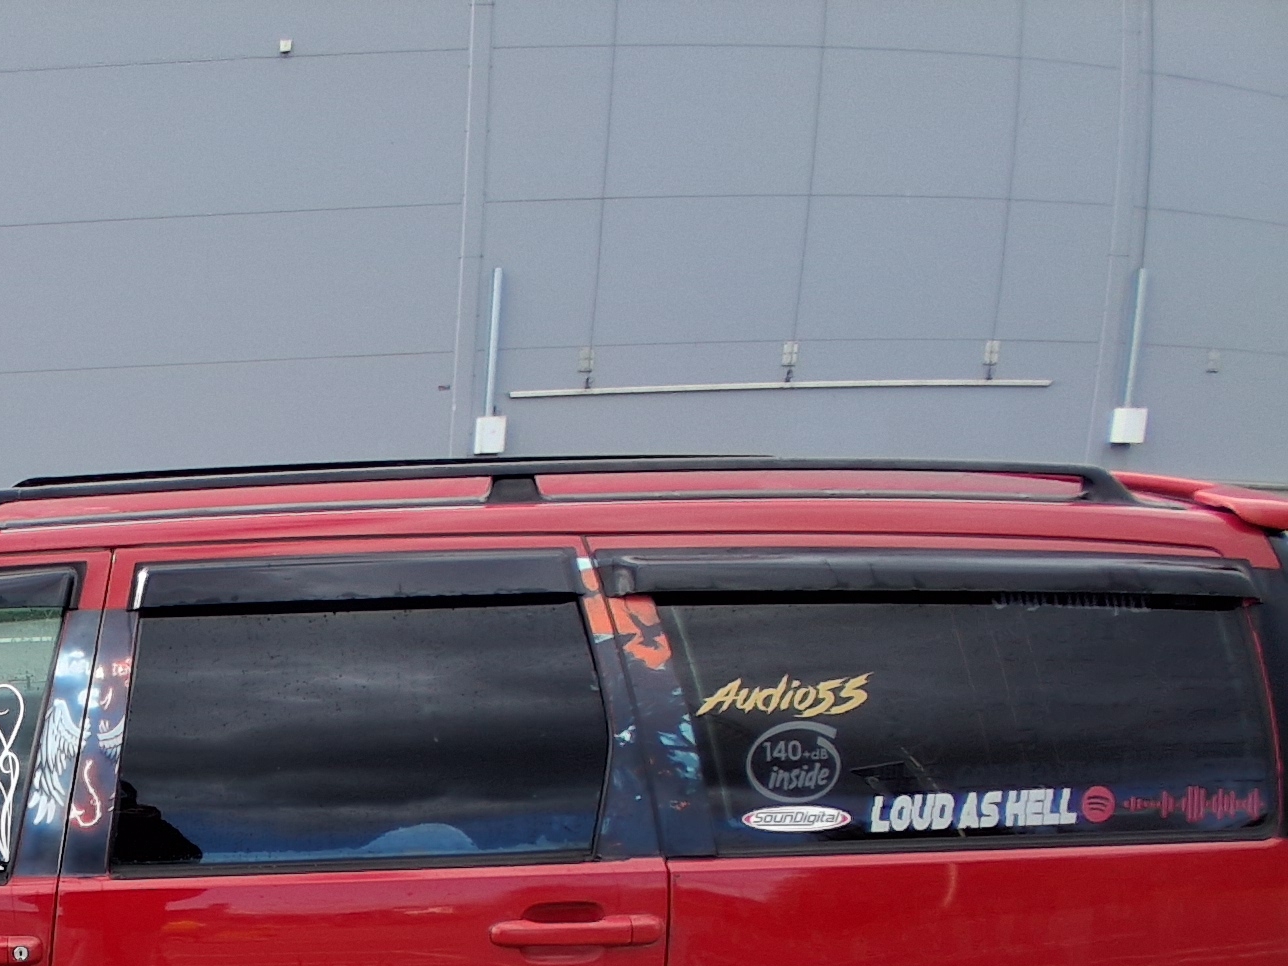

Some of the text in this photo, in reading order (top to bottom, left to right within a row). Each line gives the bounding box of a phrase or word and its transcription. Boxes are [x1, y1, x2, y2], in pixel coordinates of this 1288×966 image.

[768, 763, 830, 790] inside
[870, 787, 1078, 833] LOUD AS HELL
